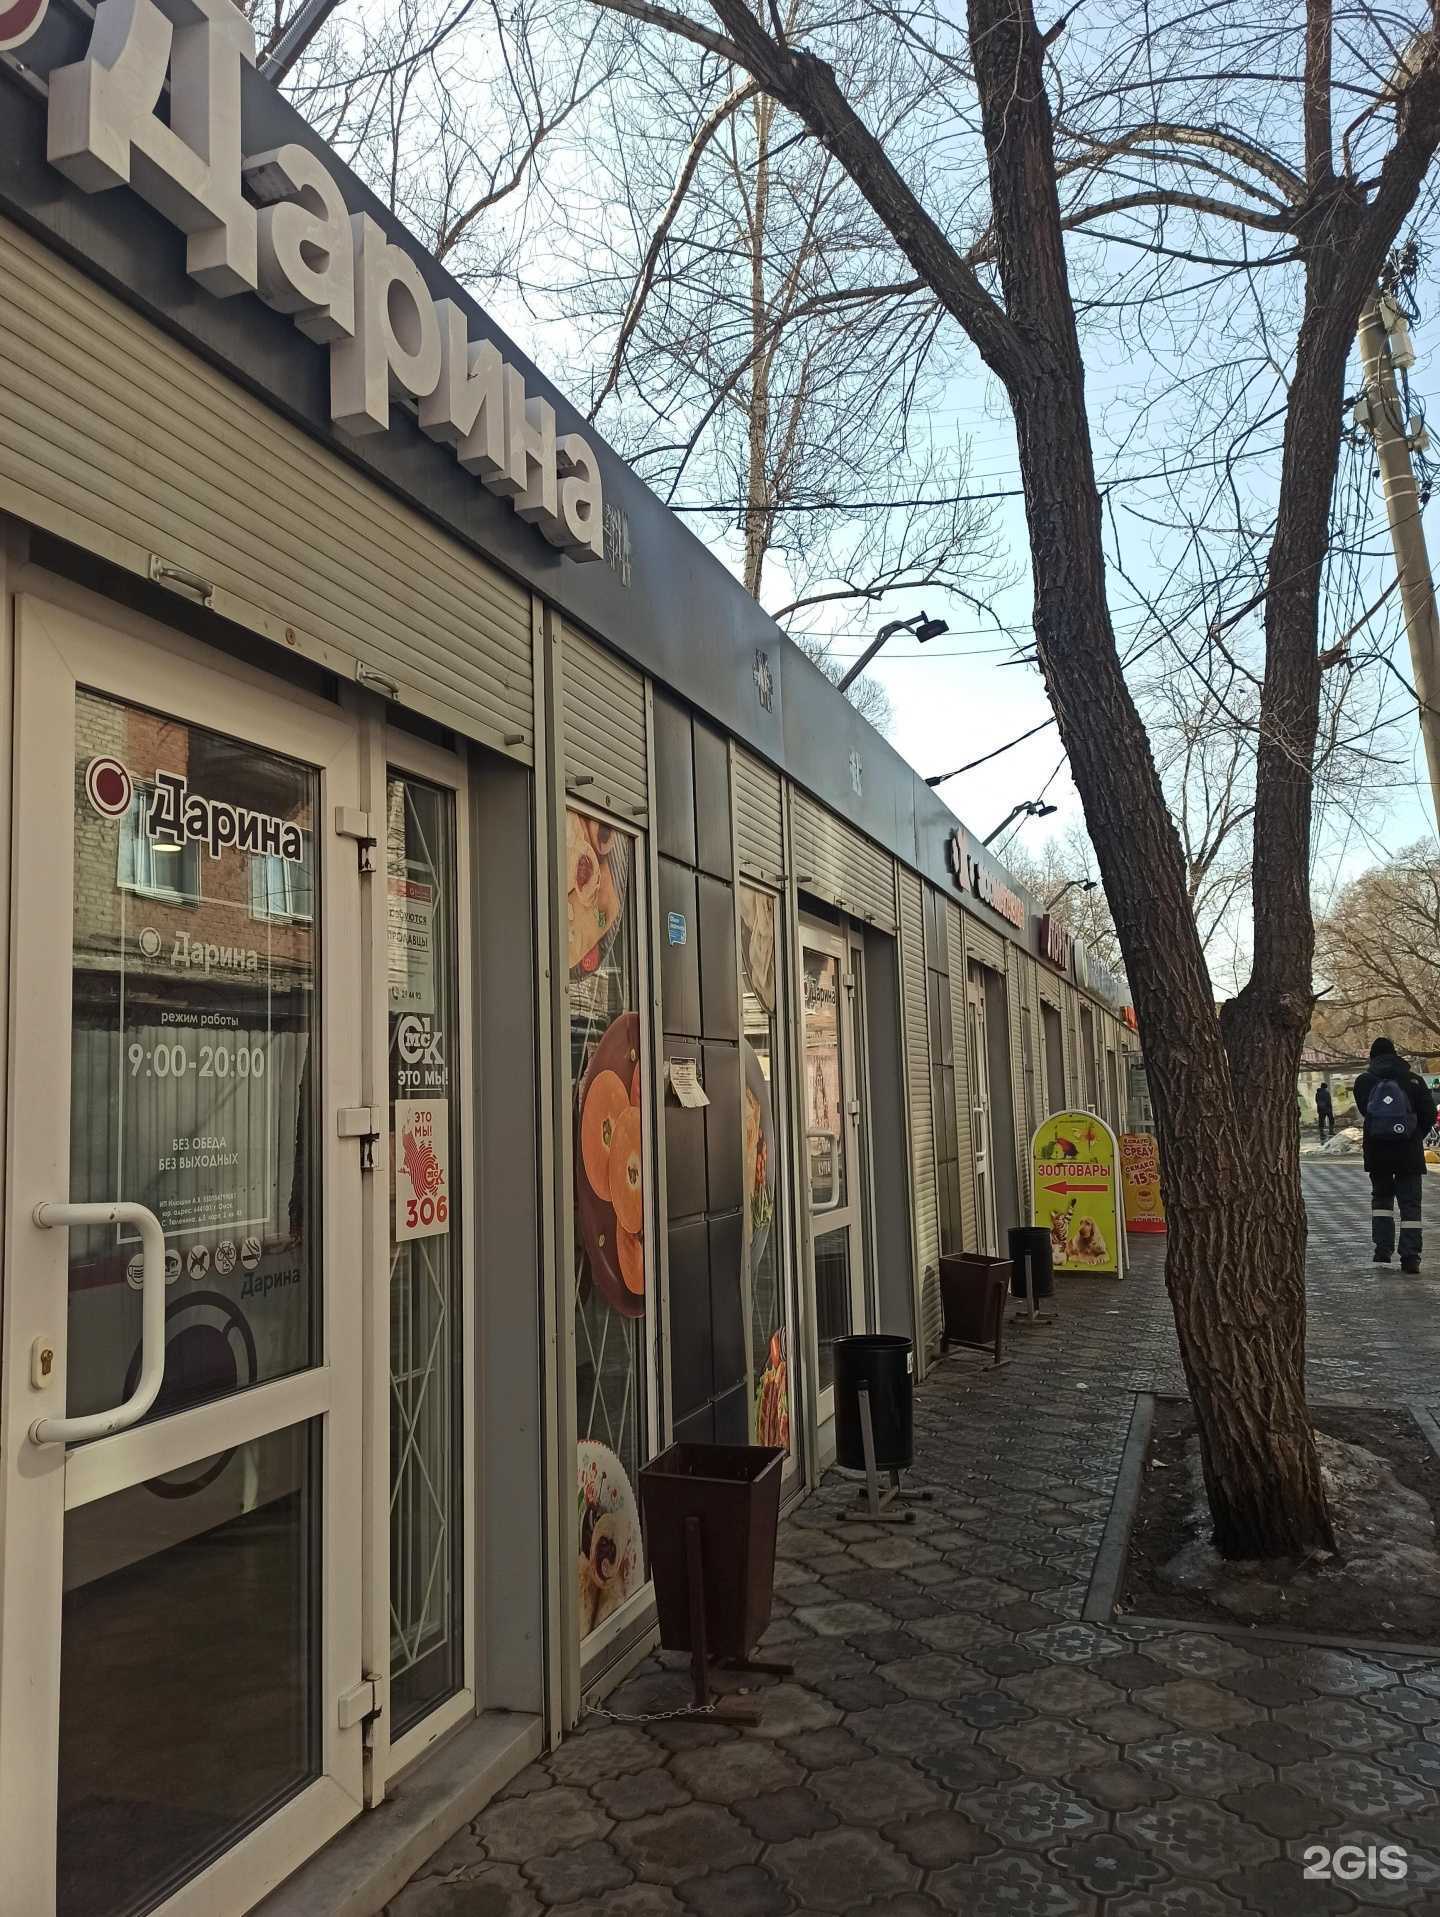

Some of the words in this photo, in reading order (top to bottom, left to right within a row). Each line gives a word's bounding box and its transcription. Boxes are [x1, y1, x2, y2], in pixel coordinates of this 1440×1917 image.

[47, 0, 605, 563] Дарина
[146, 769, 304, 863] Дарина
[387, 908, 428, 927] БУЮТСЯ
[170, 930, 258, 975] Дарина
[161, 1011, 198, 1025] режим
[201, 1014, 239, 1027] работы
[128, 1043, 265, 1078] 9:00-20:00
[397, 1070, 420, 1086] ЭТО
[424, 1067, 449, 1085] МЫ!
[414, 1111, 432, 1122] ЭТО
[414, 1125, 432, 1138] МЫ!
[172, 1138, 190, 1151] БЕЗ
[192, 1136, 227, 1149] ОБЕДА
[158, 1158, 177, 1171] БЕЗ
[179, 1153, 239, 1168] ВЫХОДНЫХ
[1038, 1164, 1111, 1177] ЗООТОВАРЫ
[405, 1195, 448, 1228] 306
[241, 1269, 300, 1299] Дарина
